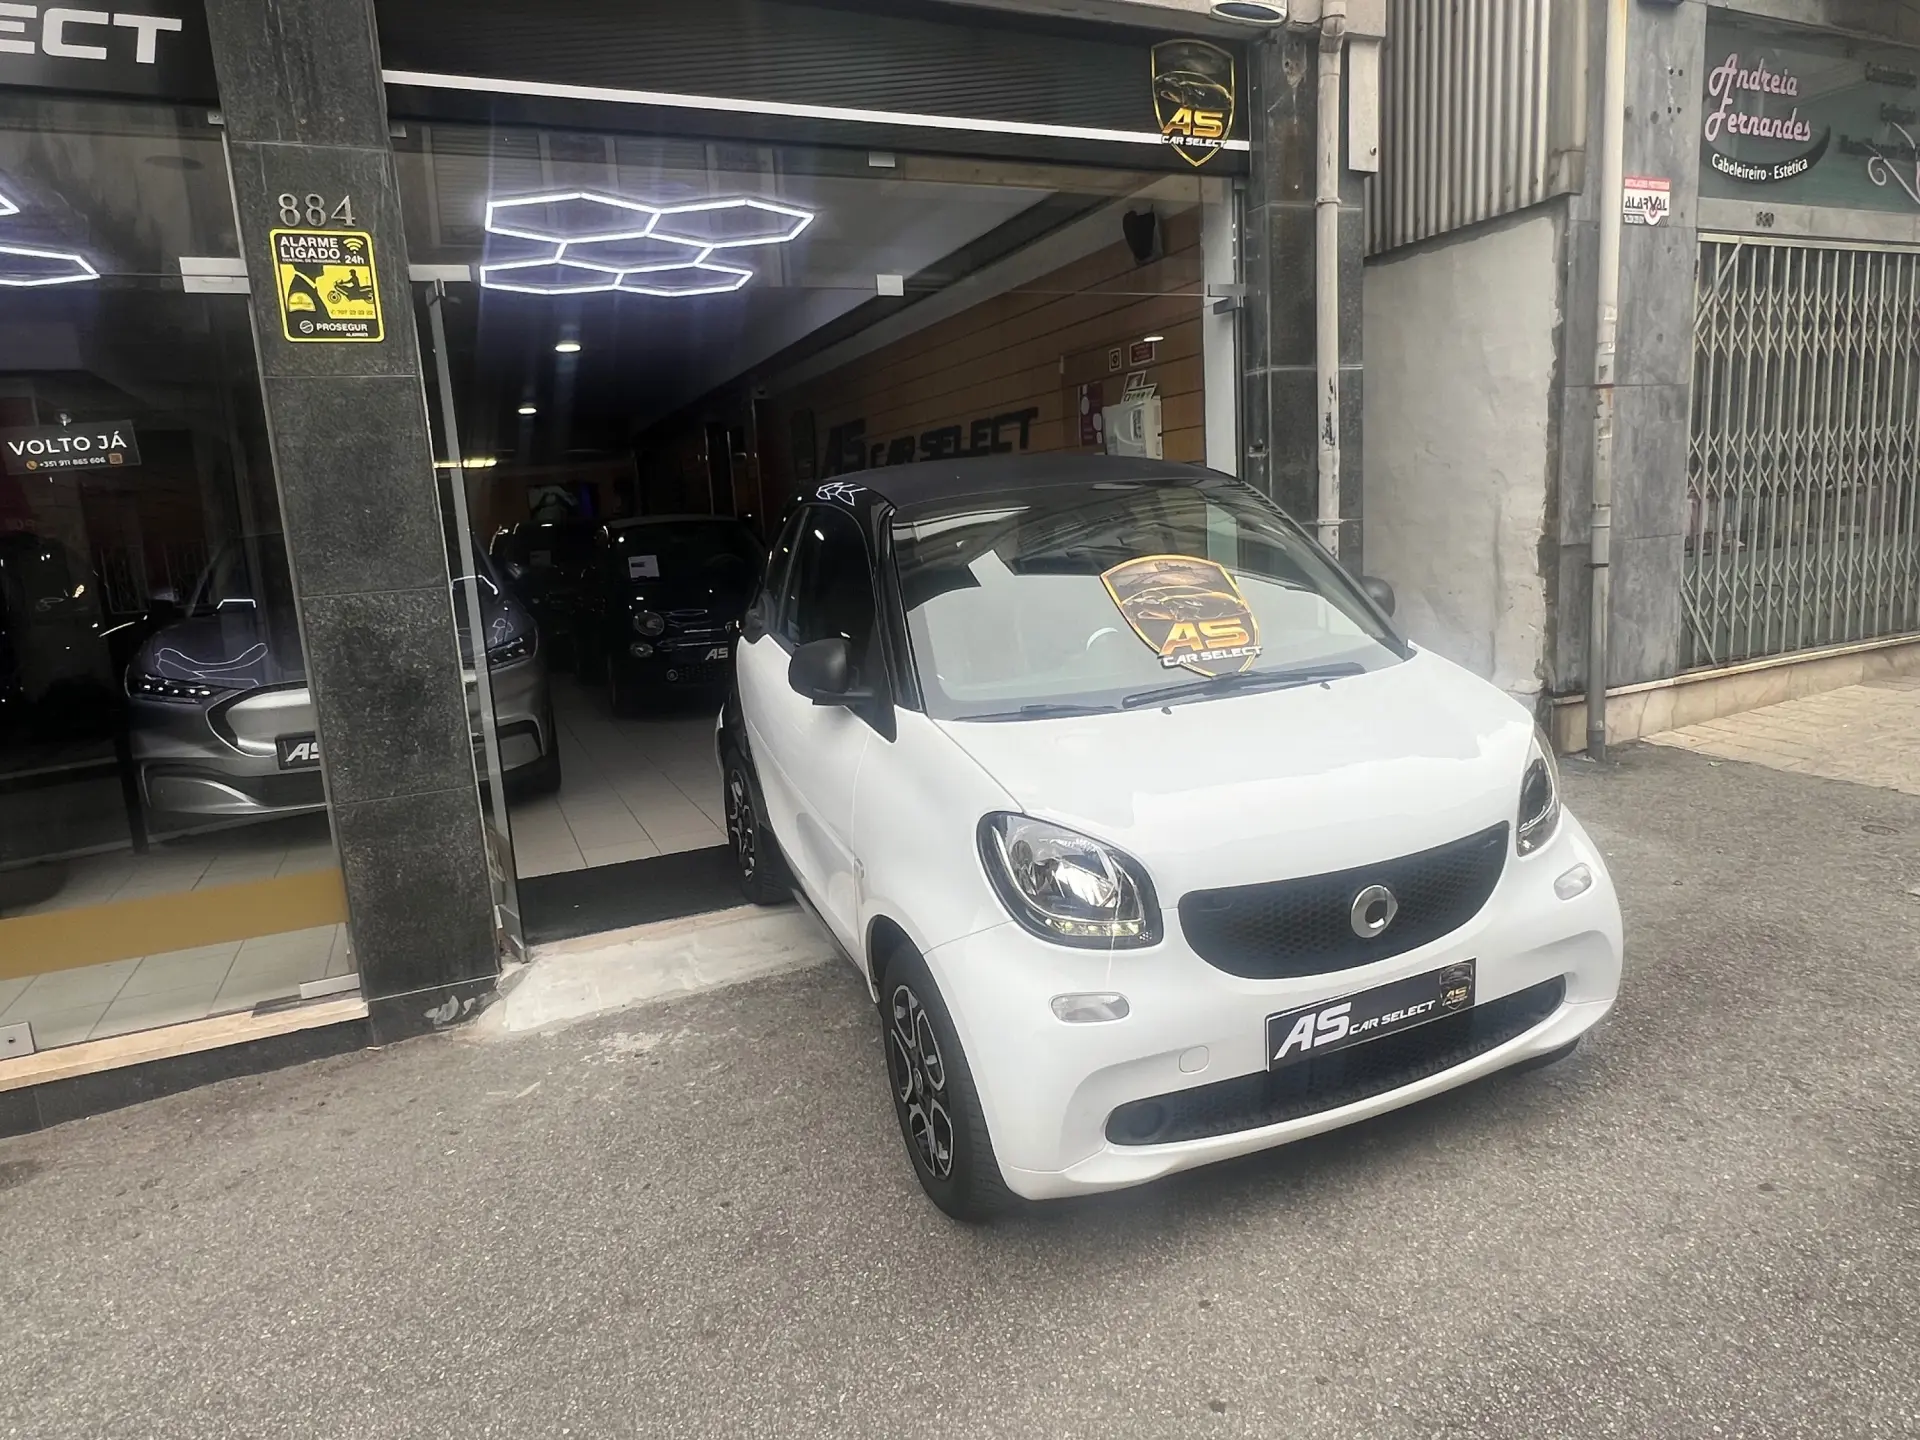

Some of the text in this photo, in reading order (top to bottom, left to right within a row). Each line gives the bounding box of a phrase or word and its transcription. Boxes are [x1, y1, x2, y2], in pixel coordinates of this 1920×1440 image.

[1708, 53, 1798, 96] Andreia
[1162, 107, 1223, 138] AS
[1704, 97, 1811, 141] Fernandes
[1161, 135, 1226, 148] CAR SELECT
[1711, 153, 1767, 180] Cabeleireiro
[1774, 158, 1809, 180] Estética
[278, 193, 356, 227] 884
[280, 236, 339, 248] ALARME
[280, 246, 341, 259] LIGADO
[344, 255, 365, 265] 24h
[316, 323, 368, 332] PROSEGUR
[7, 430, 127, 456] VOLTO JÁ
[919, 407, 1039, 462] SELECT
[1160, 618, 1250, 655] AS
[1163, 645, 1263, 666] CAR SELECT
[1273, 1002, 1352, 1060] AS
[1350, 1016, 1379, 1035] CAR
[1380, 1000, 1436, 1026] SELECT
